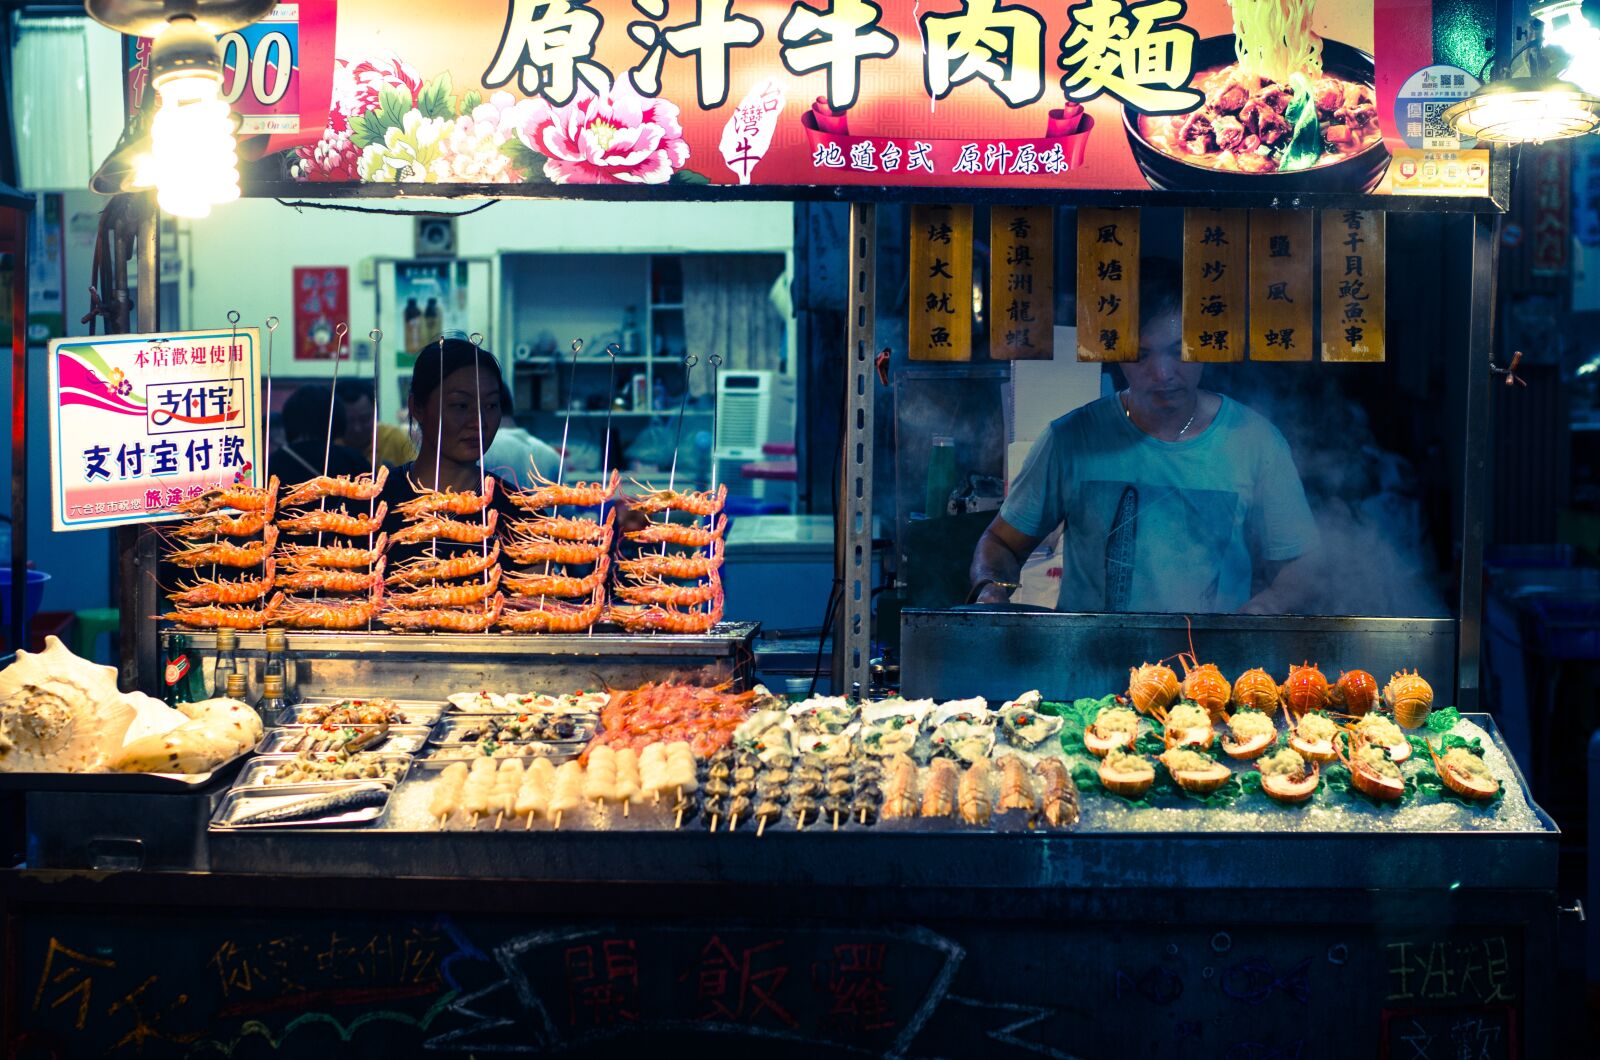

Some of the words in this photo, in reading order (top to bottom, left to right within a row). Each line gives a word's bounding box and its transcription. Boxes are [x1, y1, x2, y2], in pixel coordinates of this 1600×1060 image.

[482, 0, 1207, 116] 原汁牛肉麵
[727, 81, 781, 177] 台灣牛
[813, 141, 935, 173] 地道台式
[952, 142, 1069, 174] 原汁原味
[925, 204, 956, 349] 烤大魷魚
[1005, 205, 1036, 349] 香澳洲龍蝦
[1096, 206, 1123, 351] 風塘炒蟹
[1199, 208, 1229, 350] 辣炒海螺
[133, 344, 243, 369] 本店歡迎使用
[70, 500, 142, 516] 六合夜市祝您
[83, 434, 245, 479] 支付宝付款
